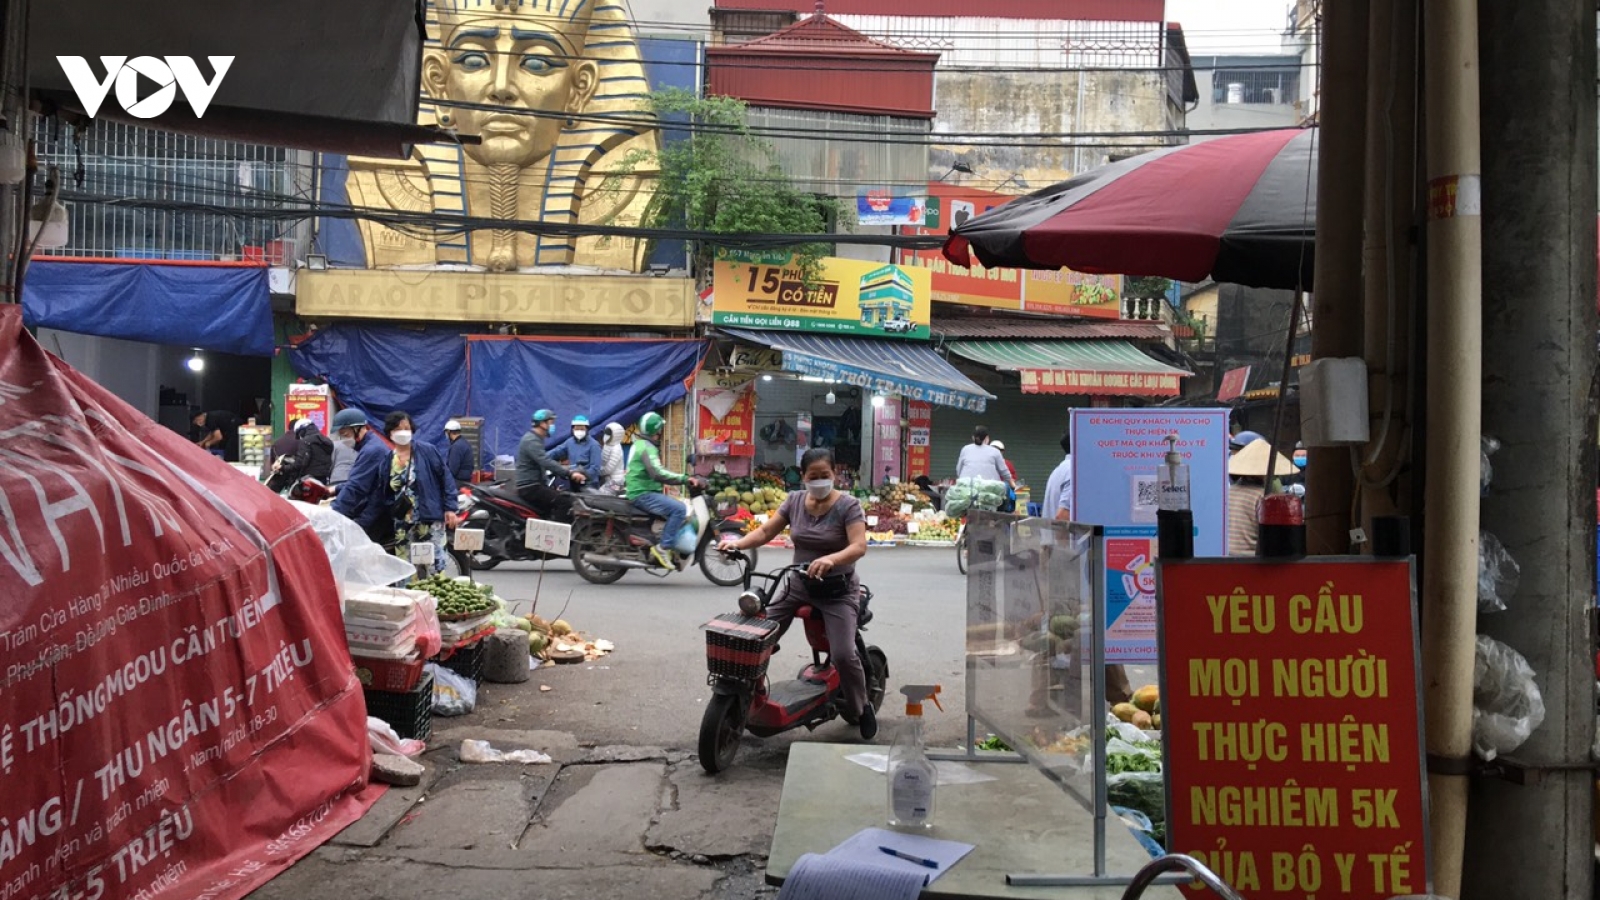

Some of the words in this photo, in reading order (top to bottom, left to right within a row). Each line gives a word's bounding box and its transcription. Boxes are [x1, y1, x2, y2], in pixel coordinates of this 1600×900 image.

[310, 283, 443, 309] KARAOKE
[748, 266, 780, 294] 15
[782, 287, 803, 302] CÓ
[807, 287, 833, 305] TIỀN
[723, 314, 738, 324] CẦN
[740, 315, 753, 325] TIỀN
[755, 318, 768, 326] GỌI
[875, 378, 923, 399] TRANG
[0, 623, 38, 652] Trăm
[40, 607, 67, 634] Cửa
[69, 591, 102, 620] Hàng
[110, 565, 150, 596] Nhiều
[153, 553, 188, 580] Quốc
[1143, 576, 1156, 586] 5K
[117, 605, 138, 625] Gia
[1206, 586, 1276, 635] YÊU
[1289, 580, 1364, 634] CẦU
[171, 624, 216, 665] CẦN
[1189, 658, 1260, 706] MỌI
[1272, 649, 1388, 698] NGƯỜI
[94, 740, 144, 801] THU
[147, 698, 221, 765] NGÂN
[261, 637, 314, 694] TRIỆU
[1193, 718, 1287, 771] THỰC
[1300, 714, 1390, 771] HIỆN
[84, 820, 104, 846] và
[105, 801, 132, 834] trách
[136, 776, 170, 812] nhiệm
[1190, 778, 1339, 828] NGHIÊM
[1353, 789, 1400, 829] 5K
[110, 803, 194, 884] TRIỆU
[150, 859, 188, 896] nhiệm
[1187, 837, 1261, 892] CỦA
[1272, 843, 1322, 900] BỘ
[1333, 852, 1357, 894] Y
[1368, 840, 1414, 895] TẾ
